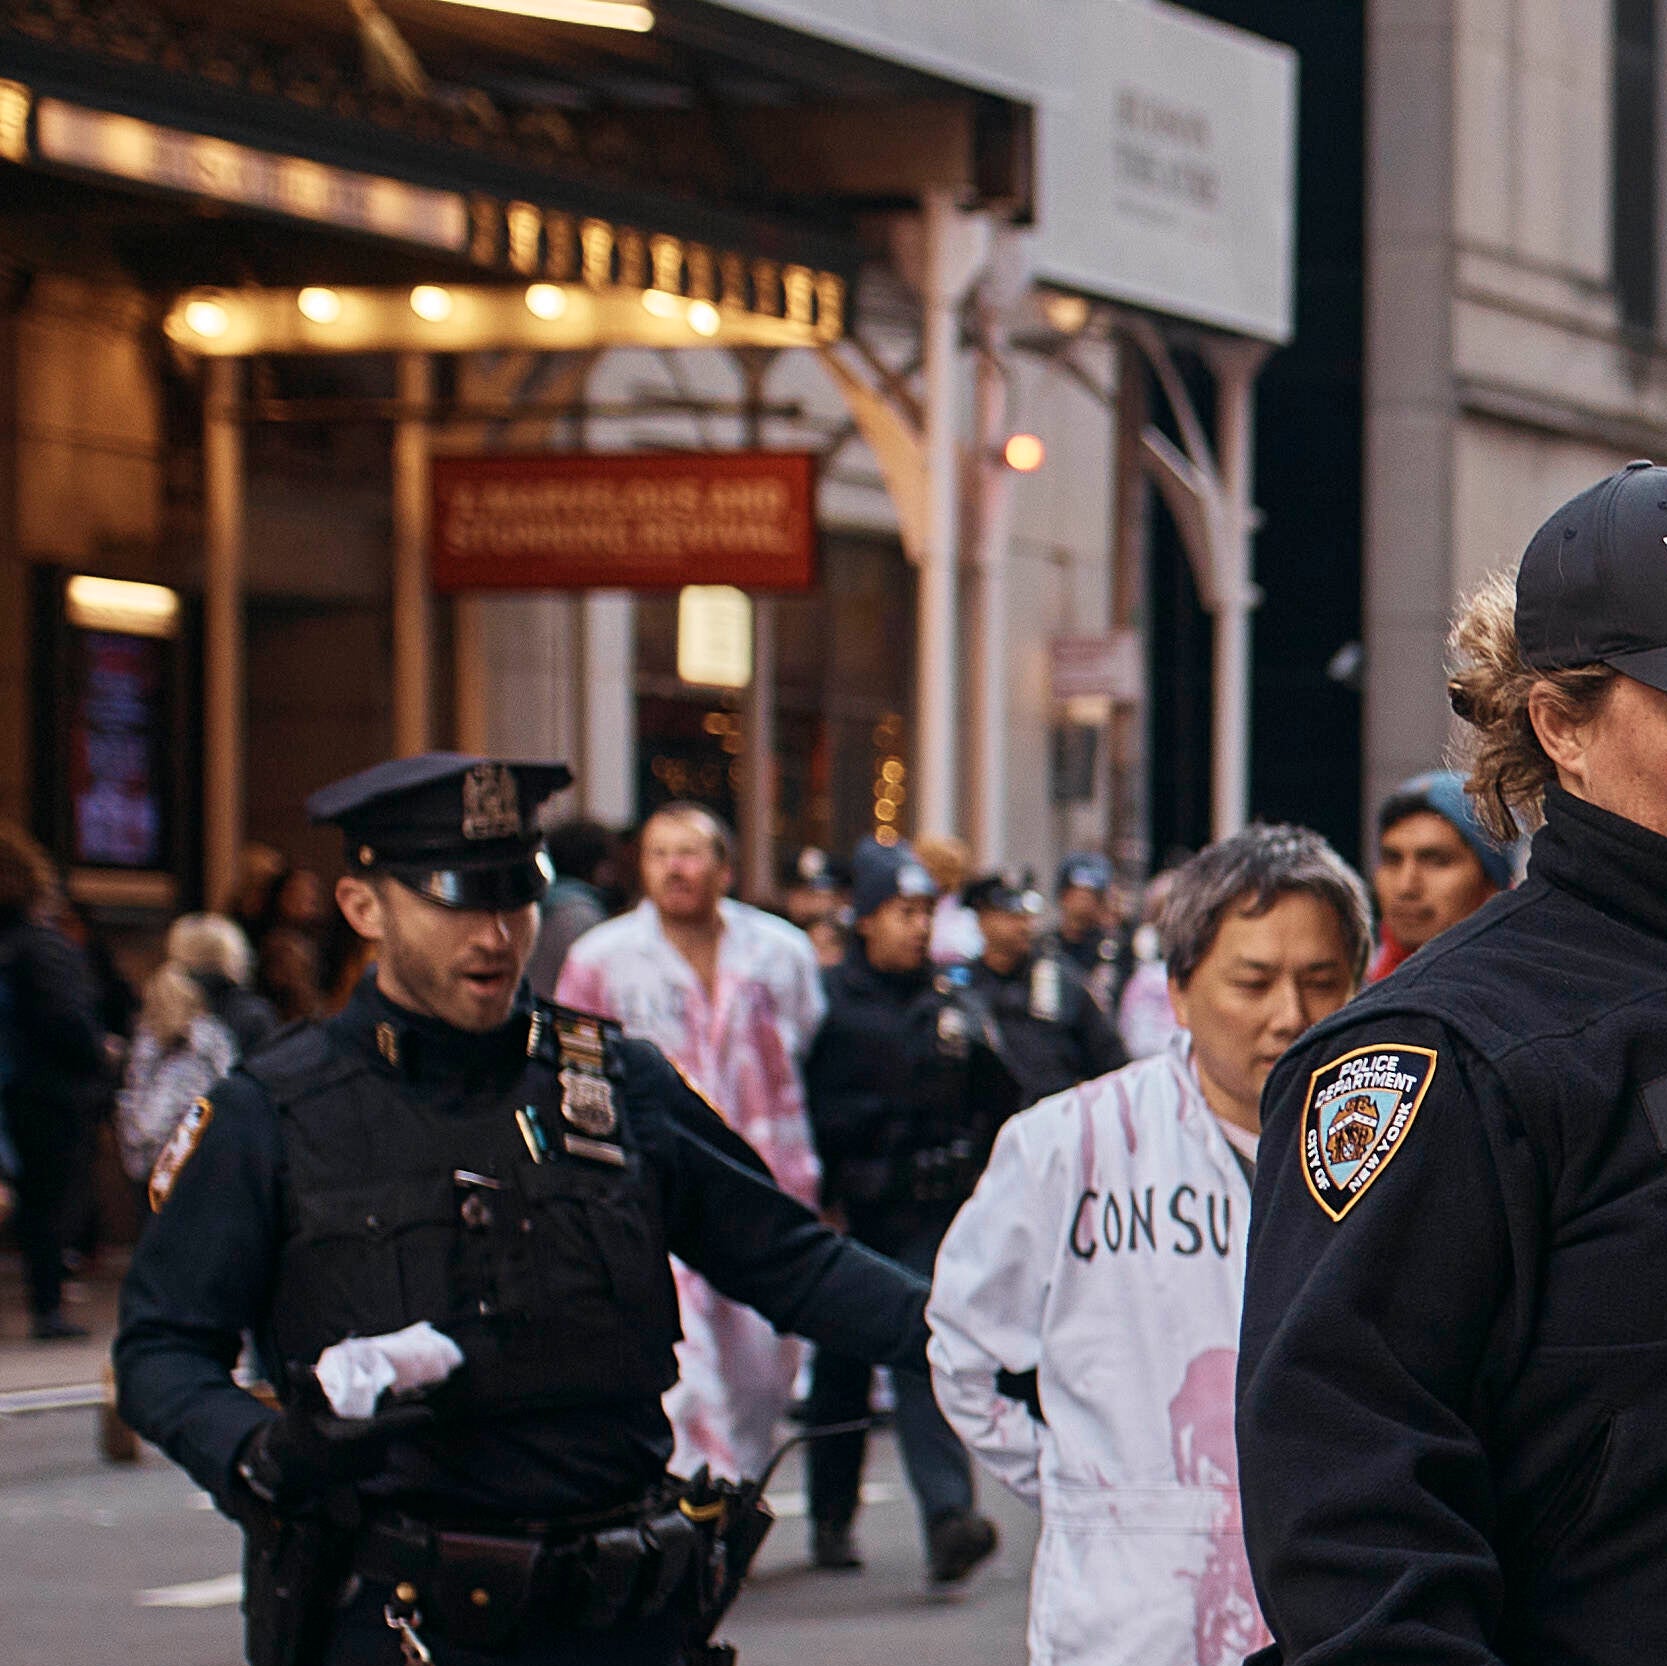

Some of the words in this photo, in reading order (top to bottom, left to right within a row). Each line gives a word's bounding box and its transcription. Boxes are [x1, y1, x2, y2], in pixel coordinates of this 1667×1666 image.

[1338, 1055, 1400, 1081] POLICE
[1315, 1071, 1418, 1109] DEPARTMENT
[1376, 1101, 1414, 1153] YORK
[1307, 1128, 1322, 1168] CITY
[1314, 1167, 1331, 1190] OF
[1347, 1152, 1381, 1194] NEW
[1070, 1184, 1234, 1263] CONSU
